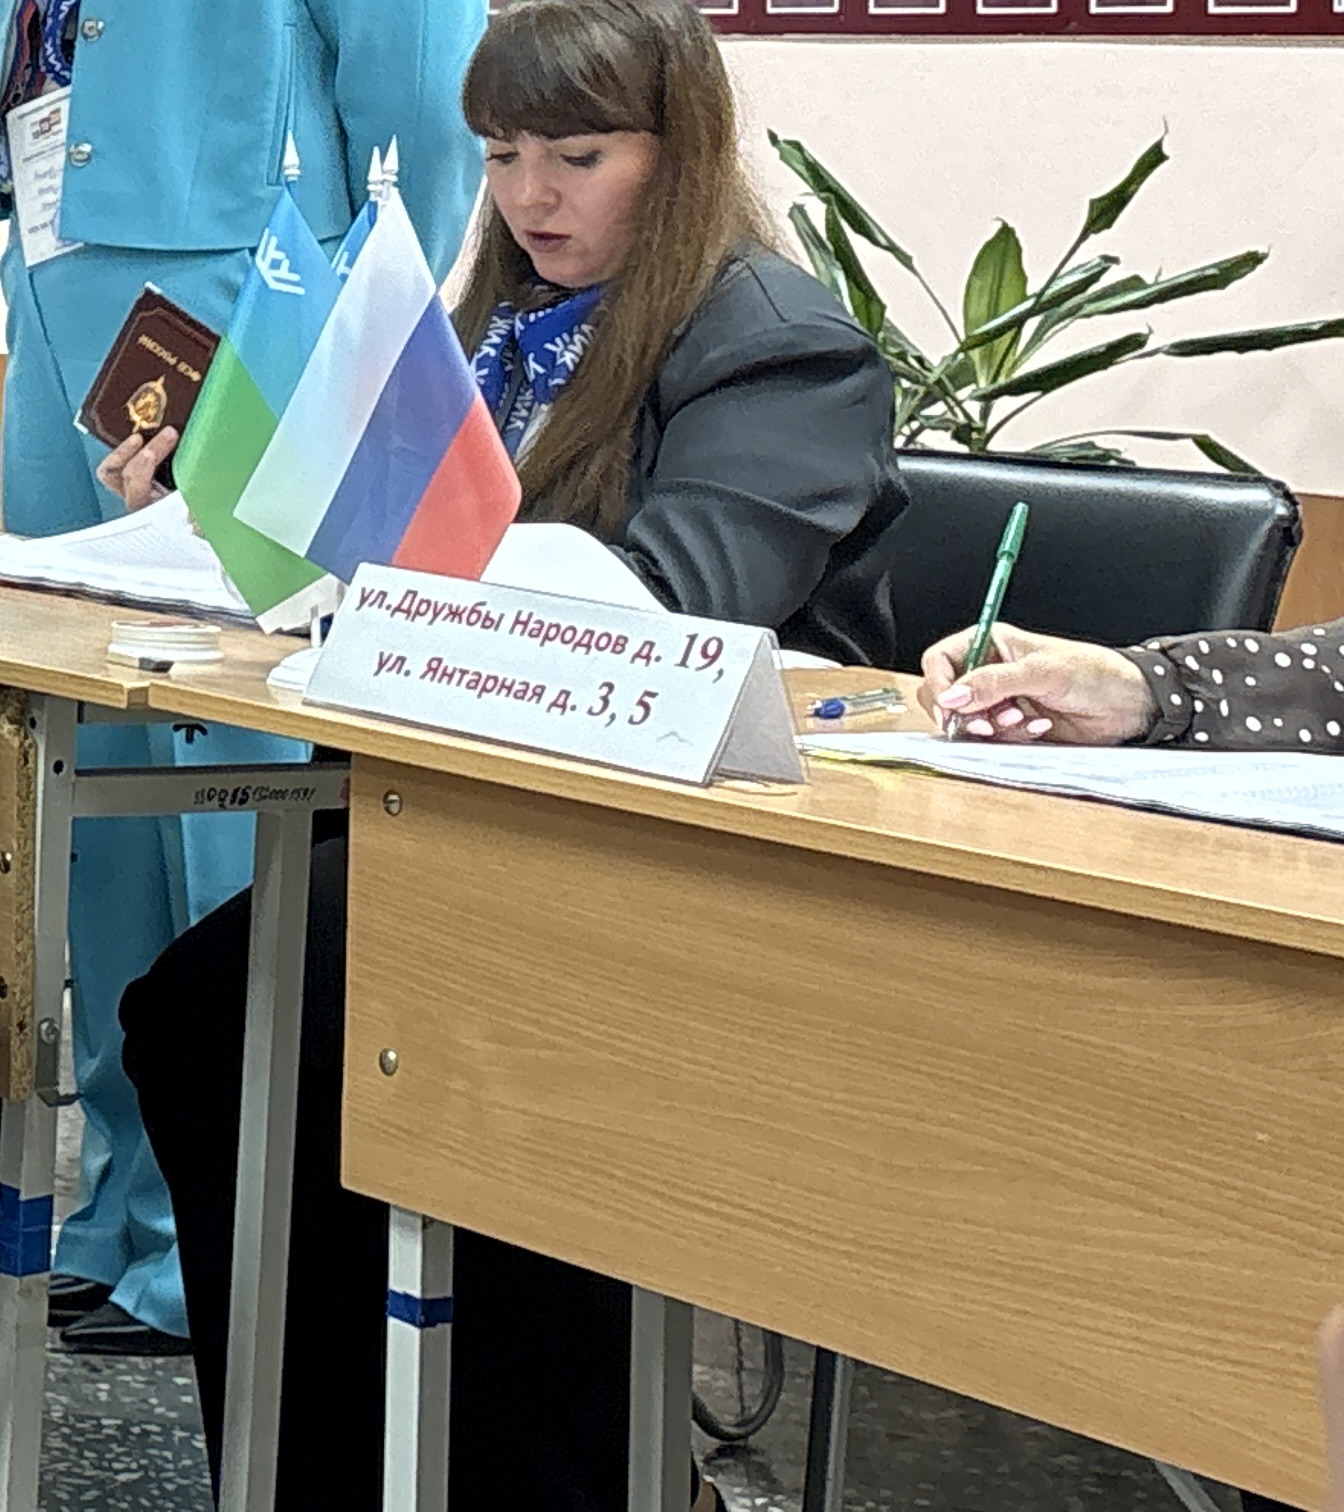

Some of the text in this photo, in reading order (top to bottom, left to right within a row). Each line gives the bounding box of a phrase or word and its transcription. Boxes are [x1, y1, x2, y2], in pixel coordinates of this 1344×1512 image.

[508, 609, 630, 656] Народов
[629, 639, 663, 668] д.
[673, 632, 725, 685] 19,
[373, 650, 412, 678] ул.
[418, 656, 547, 705] Янтарная
[545, 688, 578, 717] д.
[627, 689, 660, 726] 5
